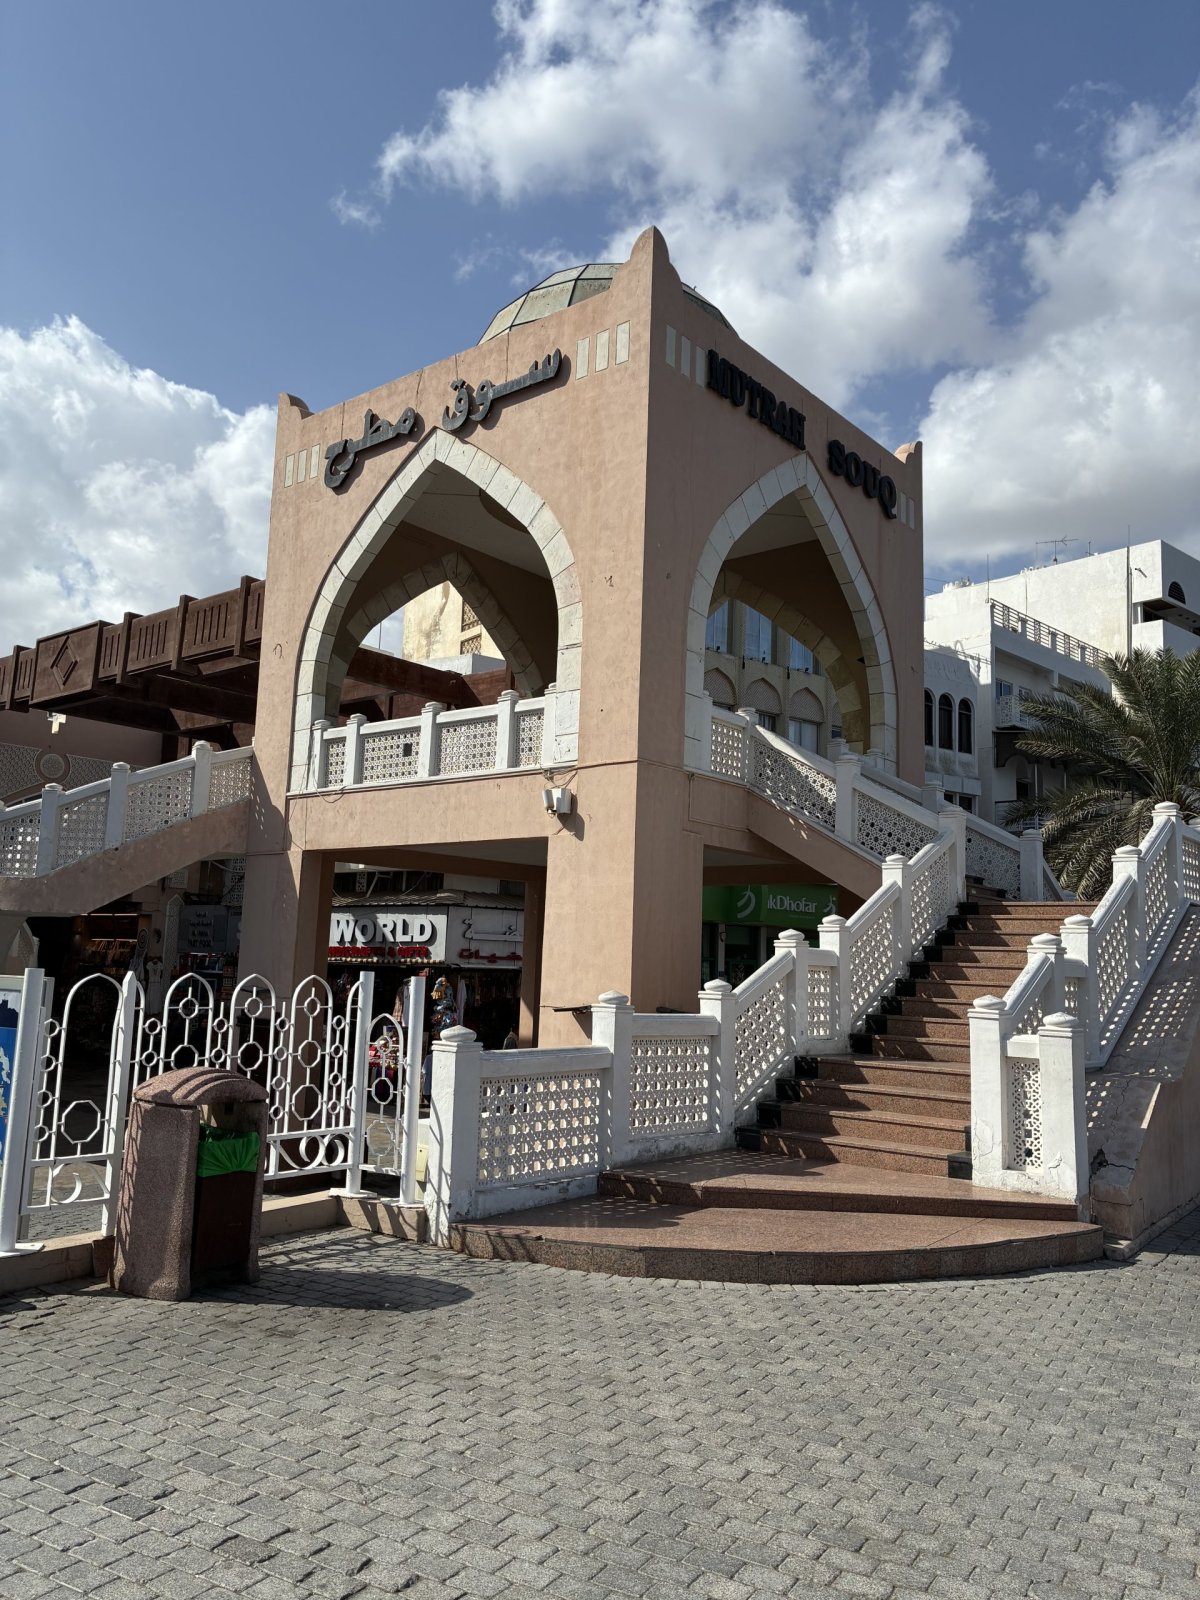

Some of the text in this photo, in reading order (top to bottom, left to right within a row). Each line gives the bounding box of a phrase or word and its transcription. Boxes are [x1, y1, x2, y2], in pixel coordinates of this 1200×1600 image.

[324, 348, 563, 488] سوق مطرح
[708, 349, 898, 520] MUTRAH SOUQ
[331, 918, 433, 943] WORLD
